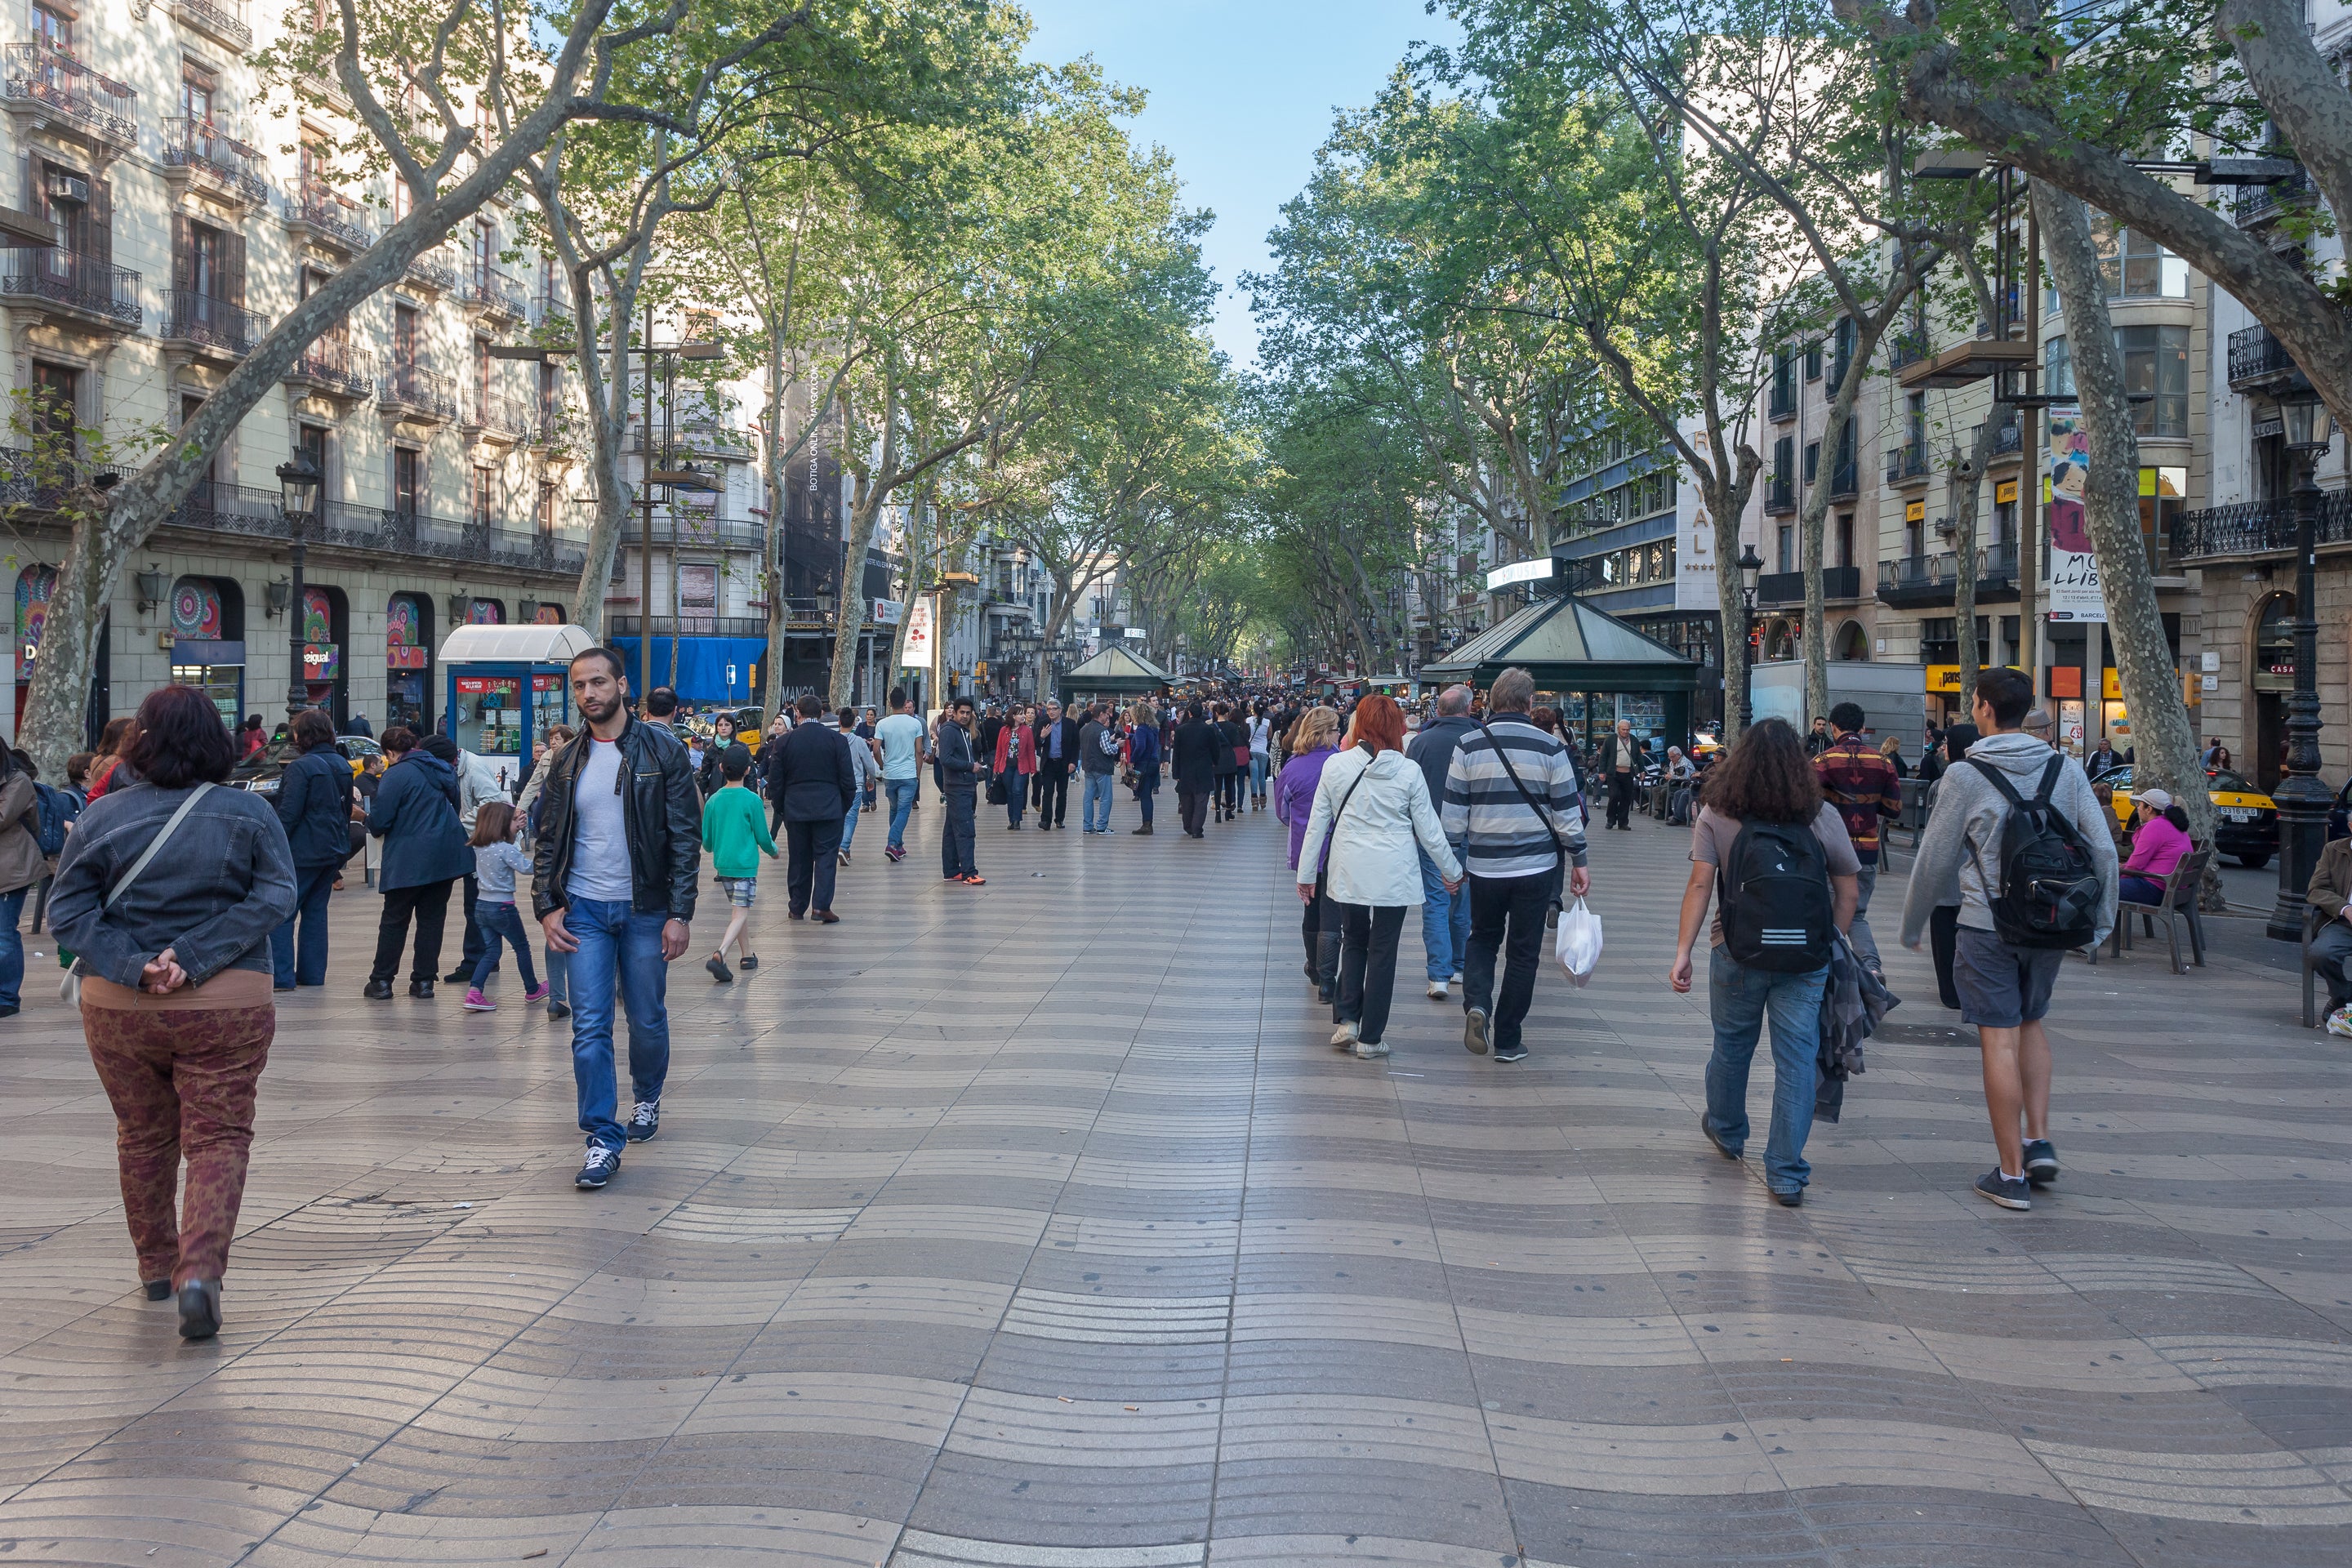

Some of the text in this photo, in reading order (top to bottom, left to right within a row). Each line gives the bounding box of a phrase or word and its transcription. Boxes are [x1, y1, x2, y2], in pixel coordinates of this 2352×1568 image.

[809, 457, 817, 491] BOTIGA
[1942, 671, 1960, 688] pans
[483, 700, 502, 708] ONCE
